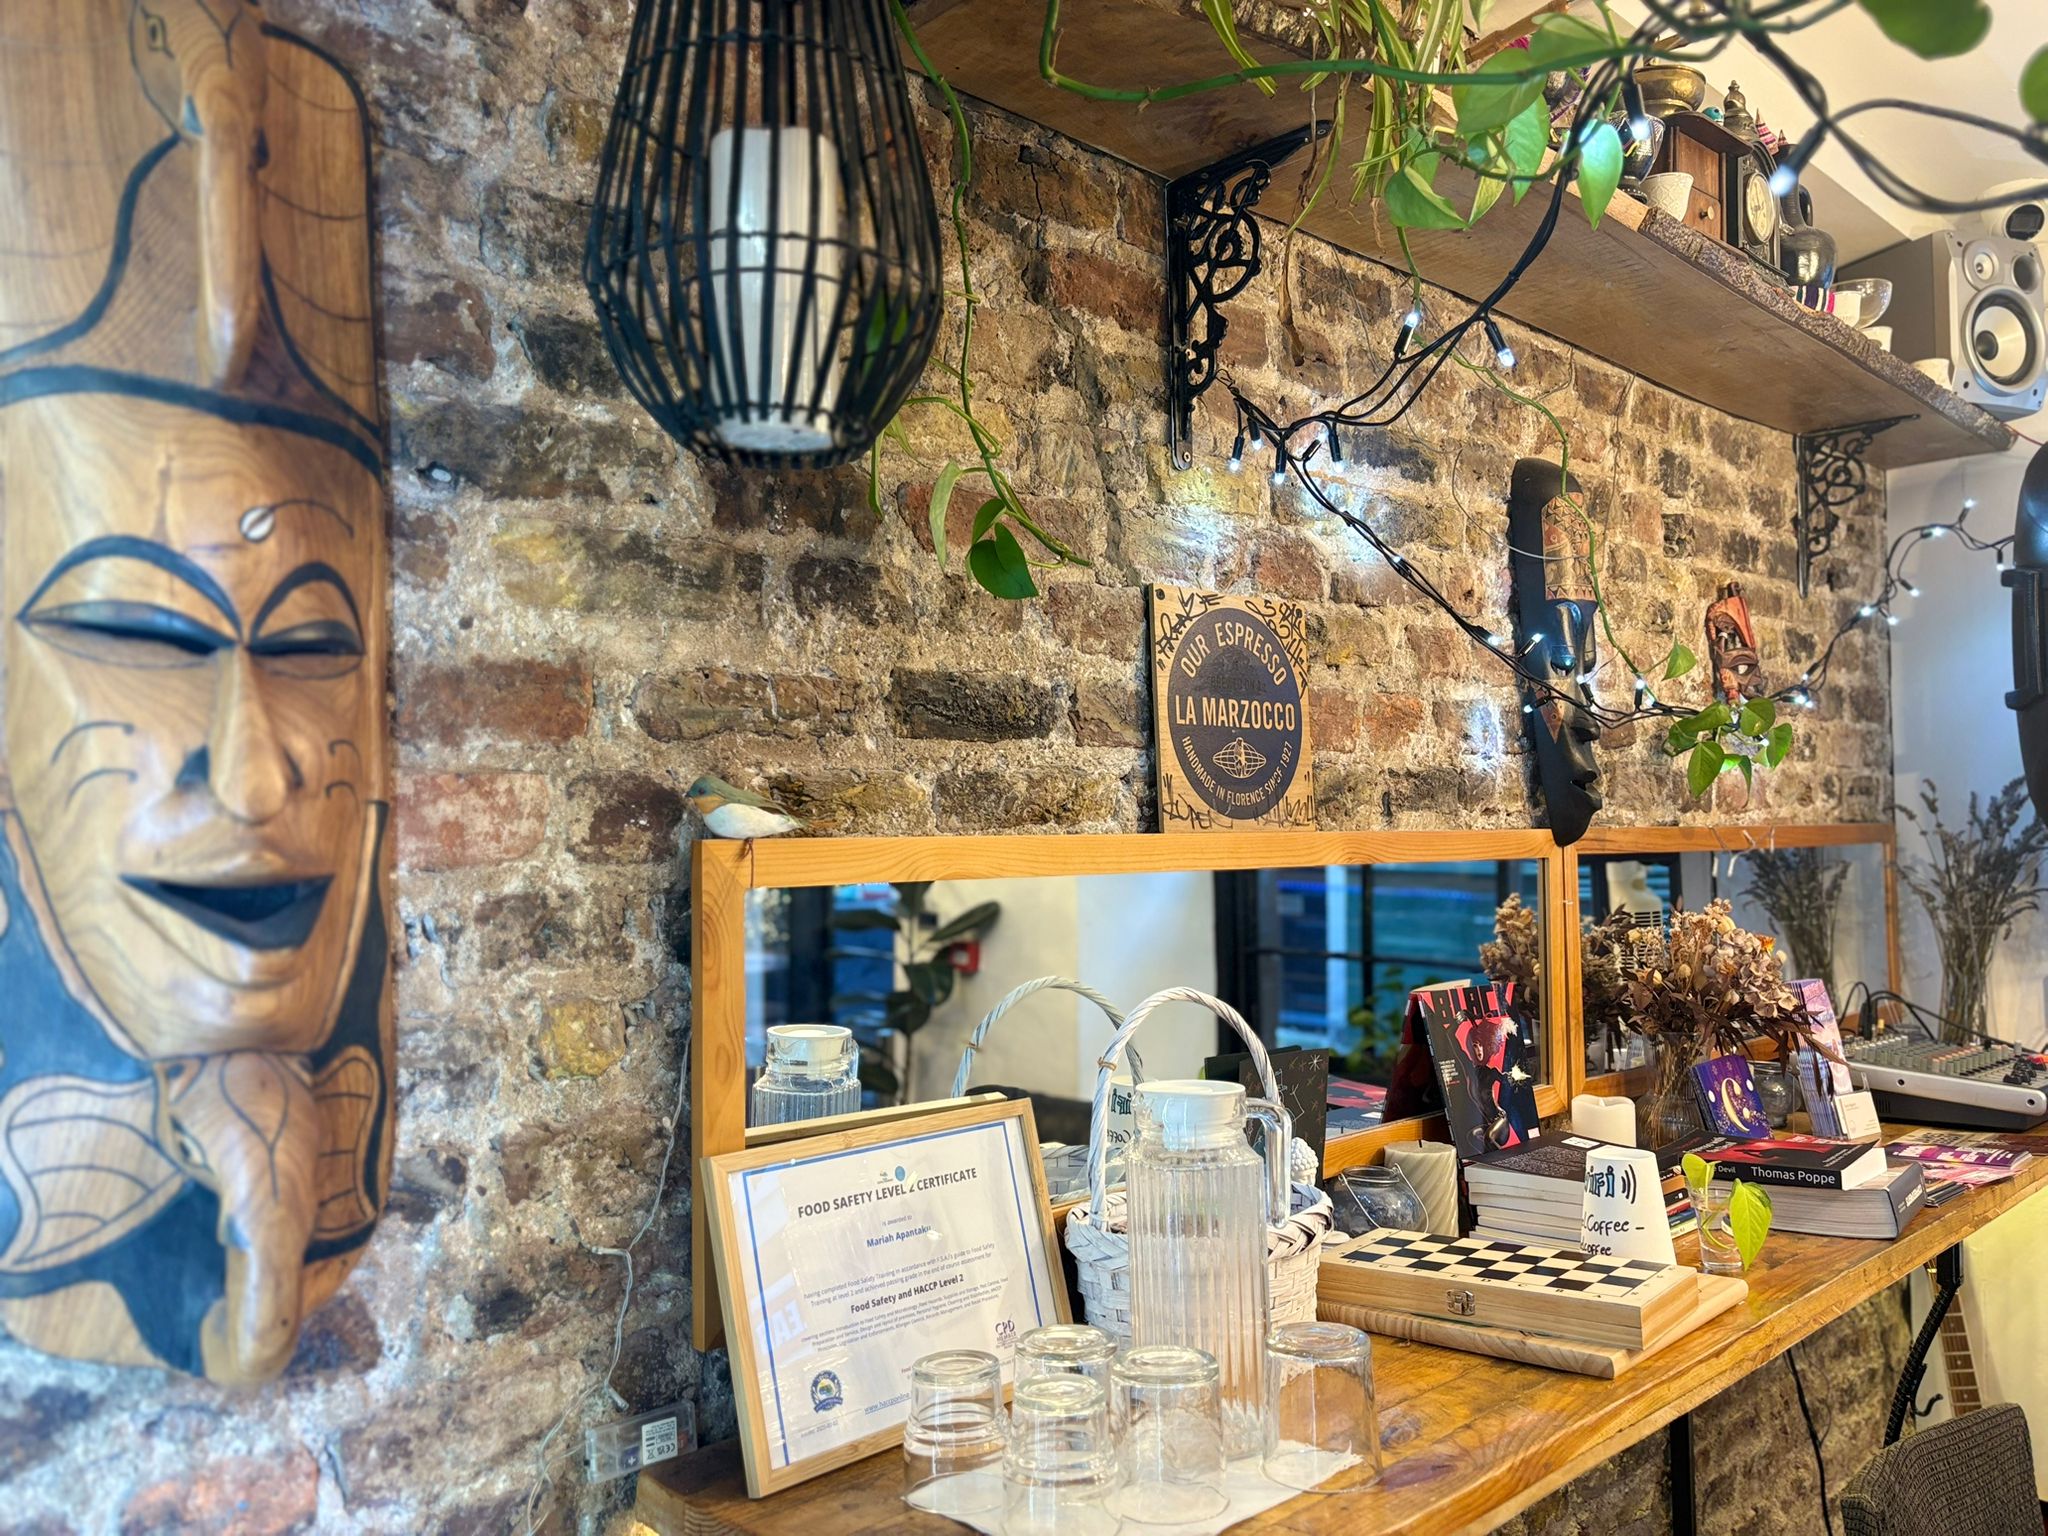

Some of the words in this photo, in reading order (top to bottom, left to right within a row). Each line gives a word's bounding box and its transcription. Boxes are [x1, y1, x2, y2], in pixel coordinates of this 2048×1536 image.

[1180, 634, 1210, 678] OUR
[1214, 622, 1287, 686] ESPRESSO
[1175, 695, 1197, 726] LA
[1202, 696, 1295, 731] MARZOCCO
[1182, 736, 1217, 793] HANDMADE
[1216, 785, 1225, 799] IN
[1226, 787, 1266, 806] FLORENCE
[1280, 740, 1294, 768] 1927
[797, 1200, 830, 1218] FOOD
[832, 1191, 872, 1210] SAFETY
[875, 1183, 906, 1200] LEVEL
[916, 1167, 977, 1190] CERTIFICATE
[1718, 1165, 1736, 1174] Devil
[1751, 1166, 1795, 1181] Thomas
[1798, 1171, 1835, 1185] Poppe
[866, 1232, 894, 1247] Mariah
[850, 1300, 870, 1313] Food
[870, 1292, 896, 1309] Safety
[897, 1287, 912, 1299] and
[913, 1280, 938, 1295] HACCP
[938, 1274, 958, 1287] Level
[958, 1273, 963, 1282] 2
[995, 1320, 1015, 1336] CPD
